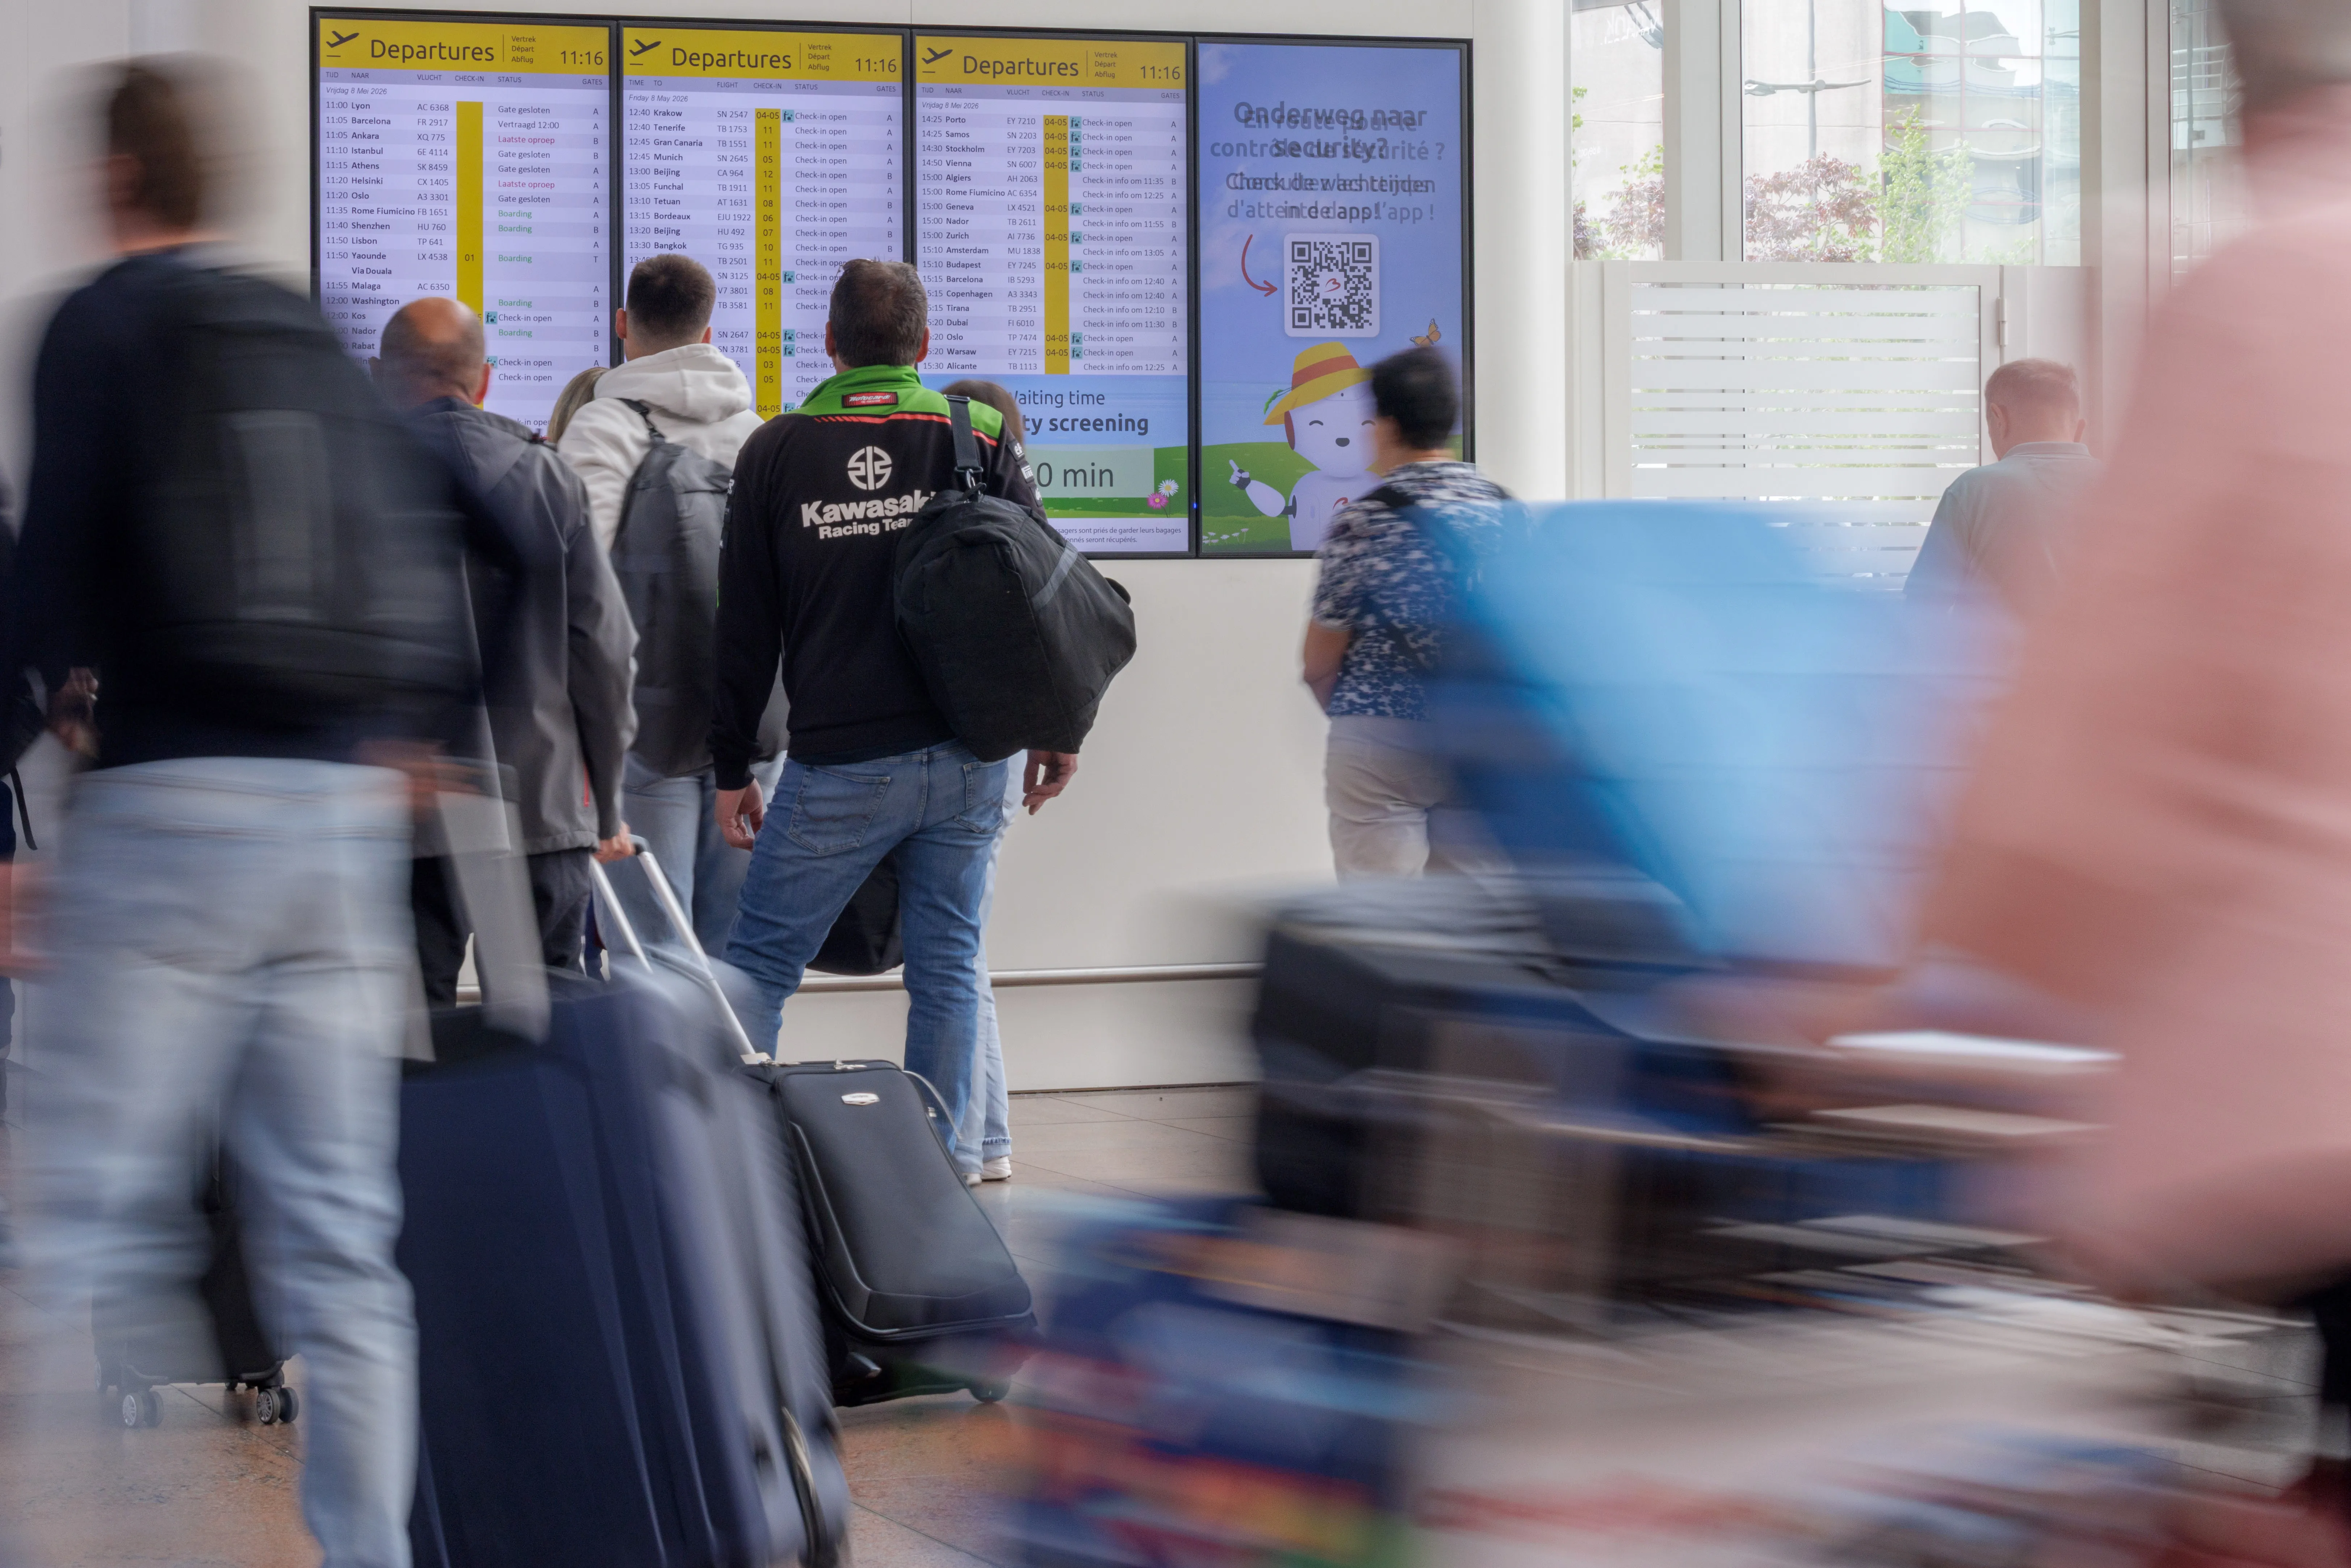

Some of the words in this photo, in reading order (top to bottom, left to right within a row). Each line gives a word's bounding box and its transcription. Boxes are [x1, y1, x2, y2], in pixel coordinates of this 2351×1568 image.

[371, 39, 494, 63] Departures
[561, 50, 603, 65] 11:16
[511, 56, 533, 64] Abflug
[672, 48, 791, 71] Departures
[855, 58, 897, 73] 11:16
[808, 63, 829, 72] Abflug
[964, 56, 1079, 79] Departures
[1140, 66, 1180, 80] 11:16
[1094, 71, 1115, 79] Abflug
[326, 87, 349, 95] Vrijdag
[629, 94, 649, 102] Friday
[352, 102, 370, 110] Lyon
[518, 106, 550, 115] gesloten
[922, 101, 943, 110] Vrijdag
[1234, 101, 1364, 129] Onderweg
[1373, 109, 1428, 126] naar
[654, 168, 680, 177] Beijing
[946, 174, 971, 183] Algiers
[1225, 172, 1285, 190] Check
[498, 254, 532, 264] Boarding
[351, 297, 399, 306] Washington
[499, 299, 532, 308] Boarding
[1069, 390, 1105, 405] time
[1049, 413, 1148, 436] screening
[1064, 462, 1113, 487] min
[819, 521, 880, 539] Racing
